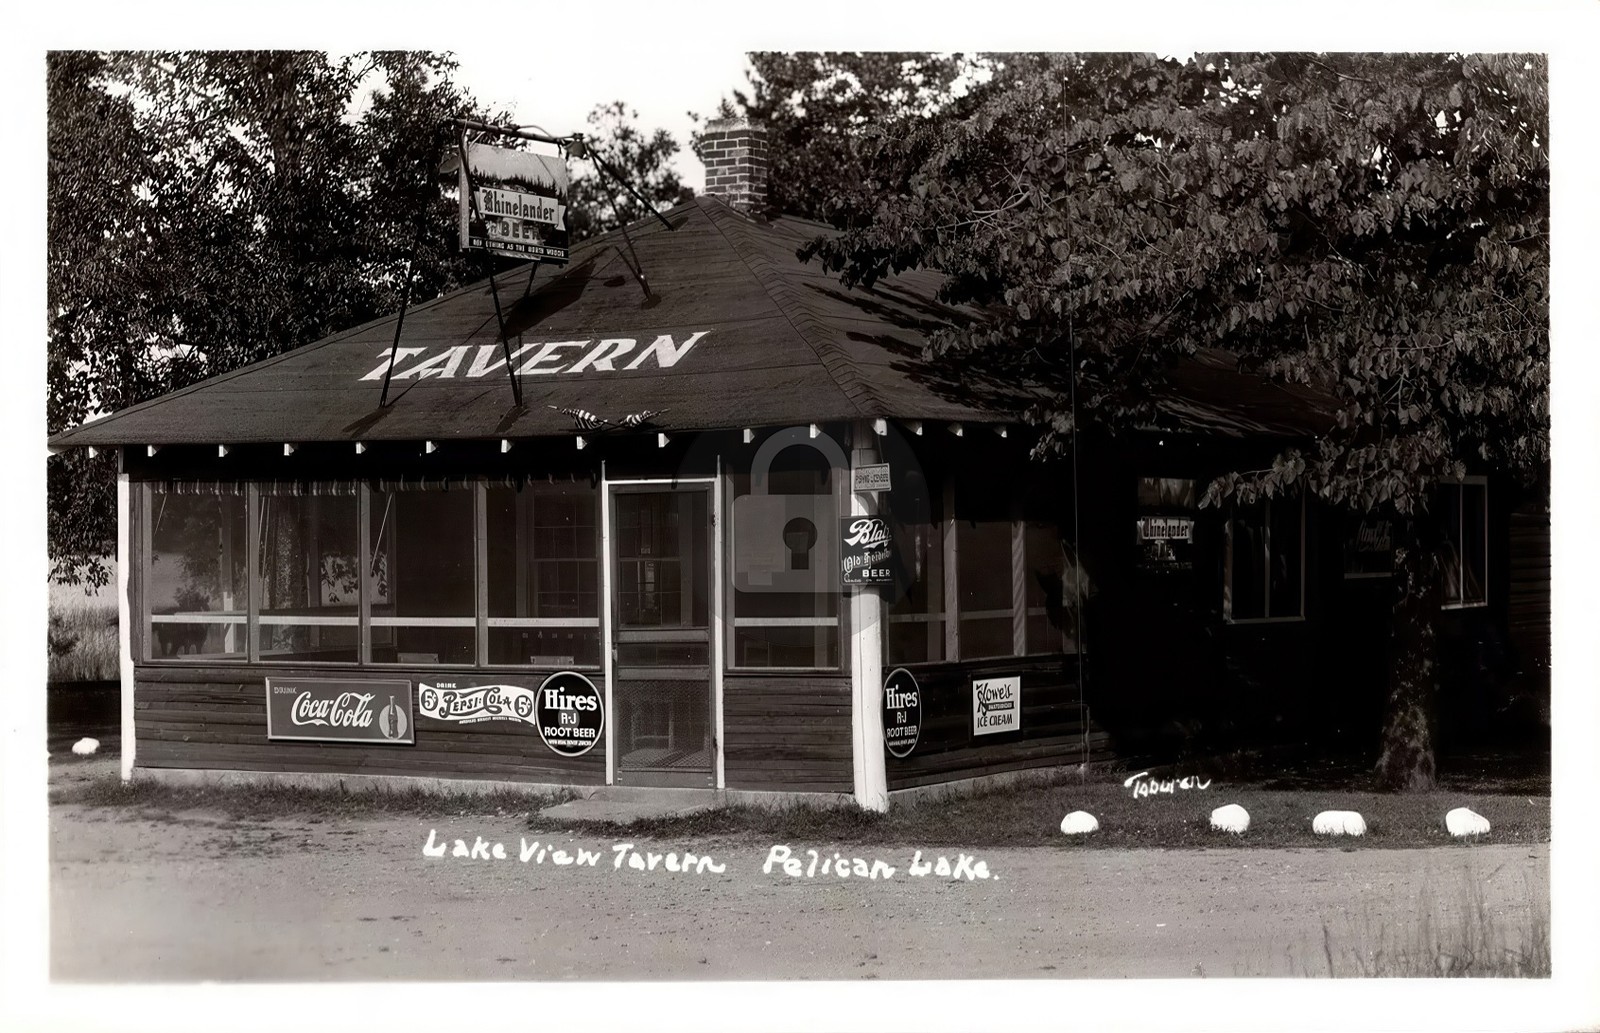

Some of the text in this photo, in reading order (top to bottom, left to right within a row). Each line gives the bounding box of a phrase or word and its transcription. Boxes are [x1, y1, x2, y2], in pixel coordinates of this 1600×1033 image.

[482, 189, 554, 221] Rhinelander
[501, 220, 541, 240] BEER
[357, 330, 711, 381] TAVERN
[843, 555, 861, 573] Old
[862, 569, 890, 577] BEER
[544, 686, 598, 711] Hires
[886, 684, 918, 709] Hires
[291, 691, 376, 728] Coca-Cola
[977, 713, 1013, 728] ICE CREAM
[544, 726, 595, 738] ROOT BEER
[887, 725, 917, 738] ROOT BEER
